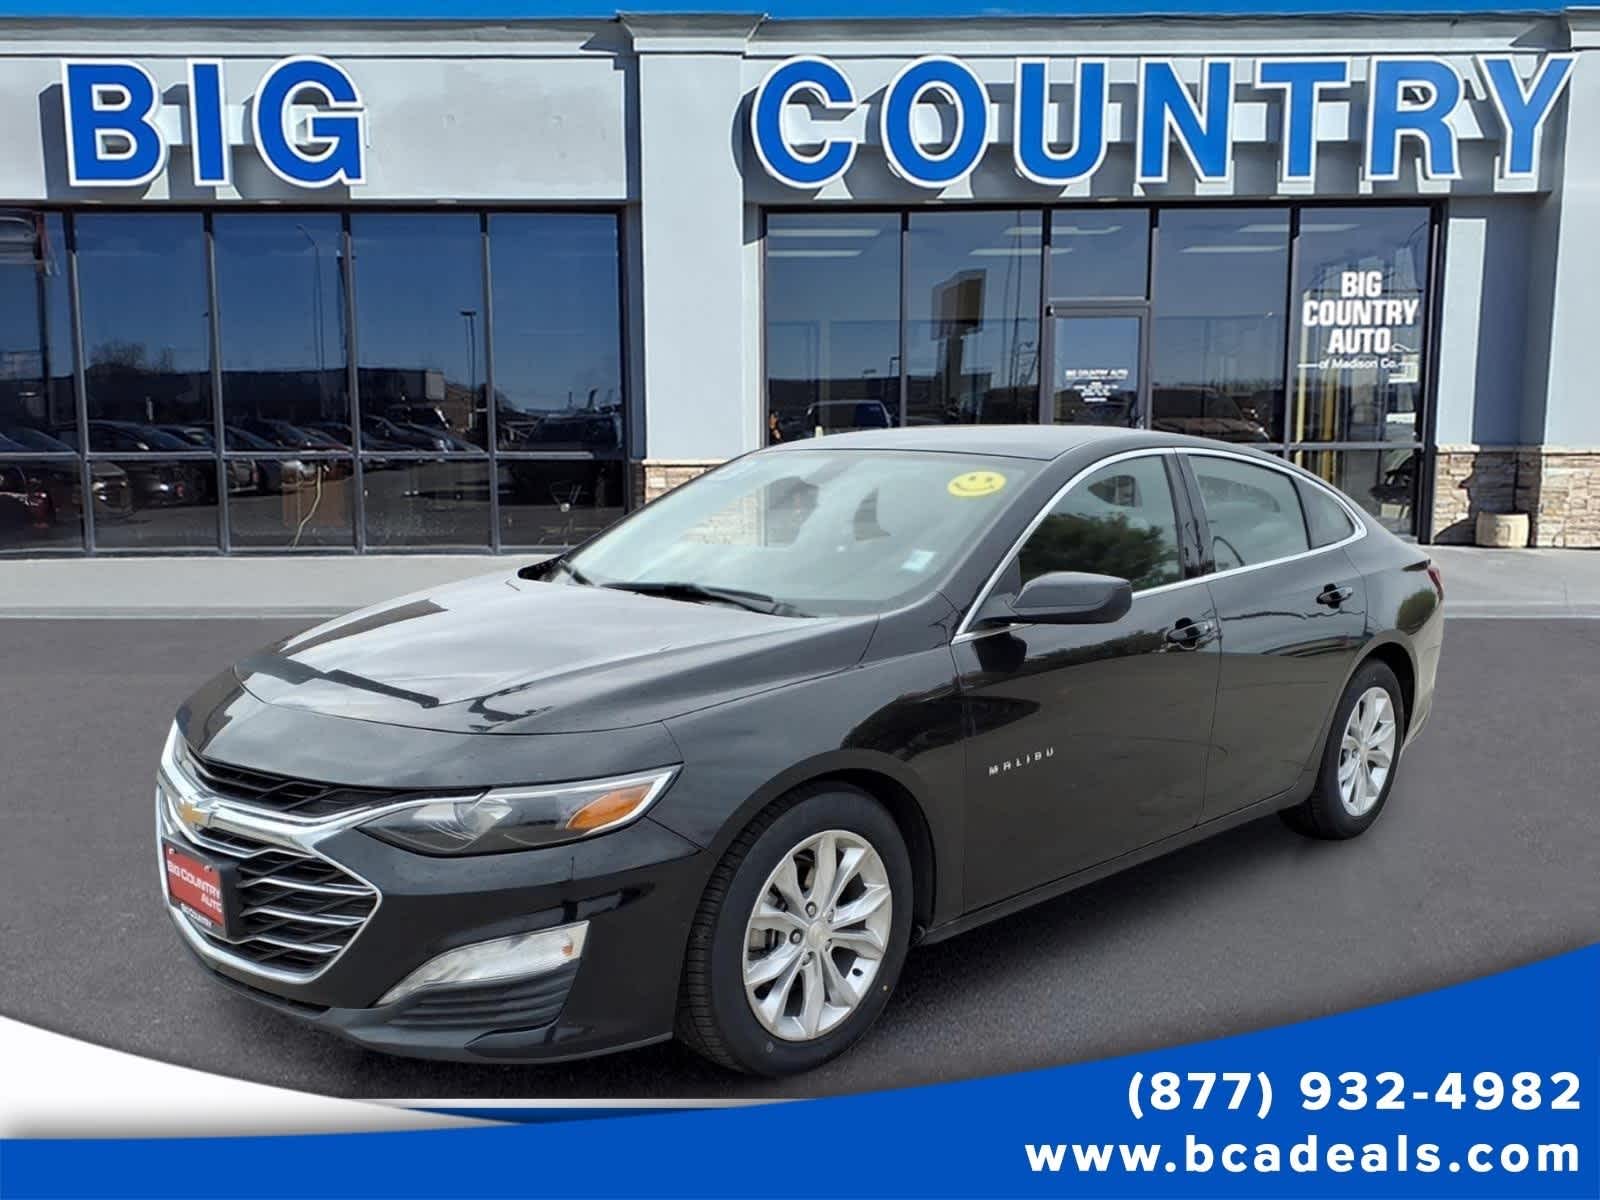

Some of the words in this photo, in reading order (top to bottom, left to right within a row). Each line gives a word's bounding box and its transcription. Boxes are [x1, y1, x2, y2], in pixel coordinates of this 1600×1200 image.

[61, 55, 367, 188] BIG
[750, 53, 1578, 190] COUNTRY
[1341, 271, 1383, 298] BIG
[1303, 299, 1419, 327] COUNTRY
[1327, 327, 1392, 354] AUTO
[1319, 358, 1329, 369] of
[1331, 358, 1378, 369] Madison
[988, 746, 1054, 776] MALIBU
